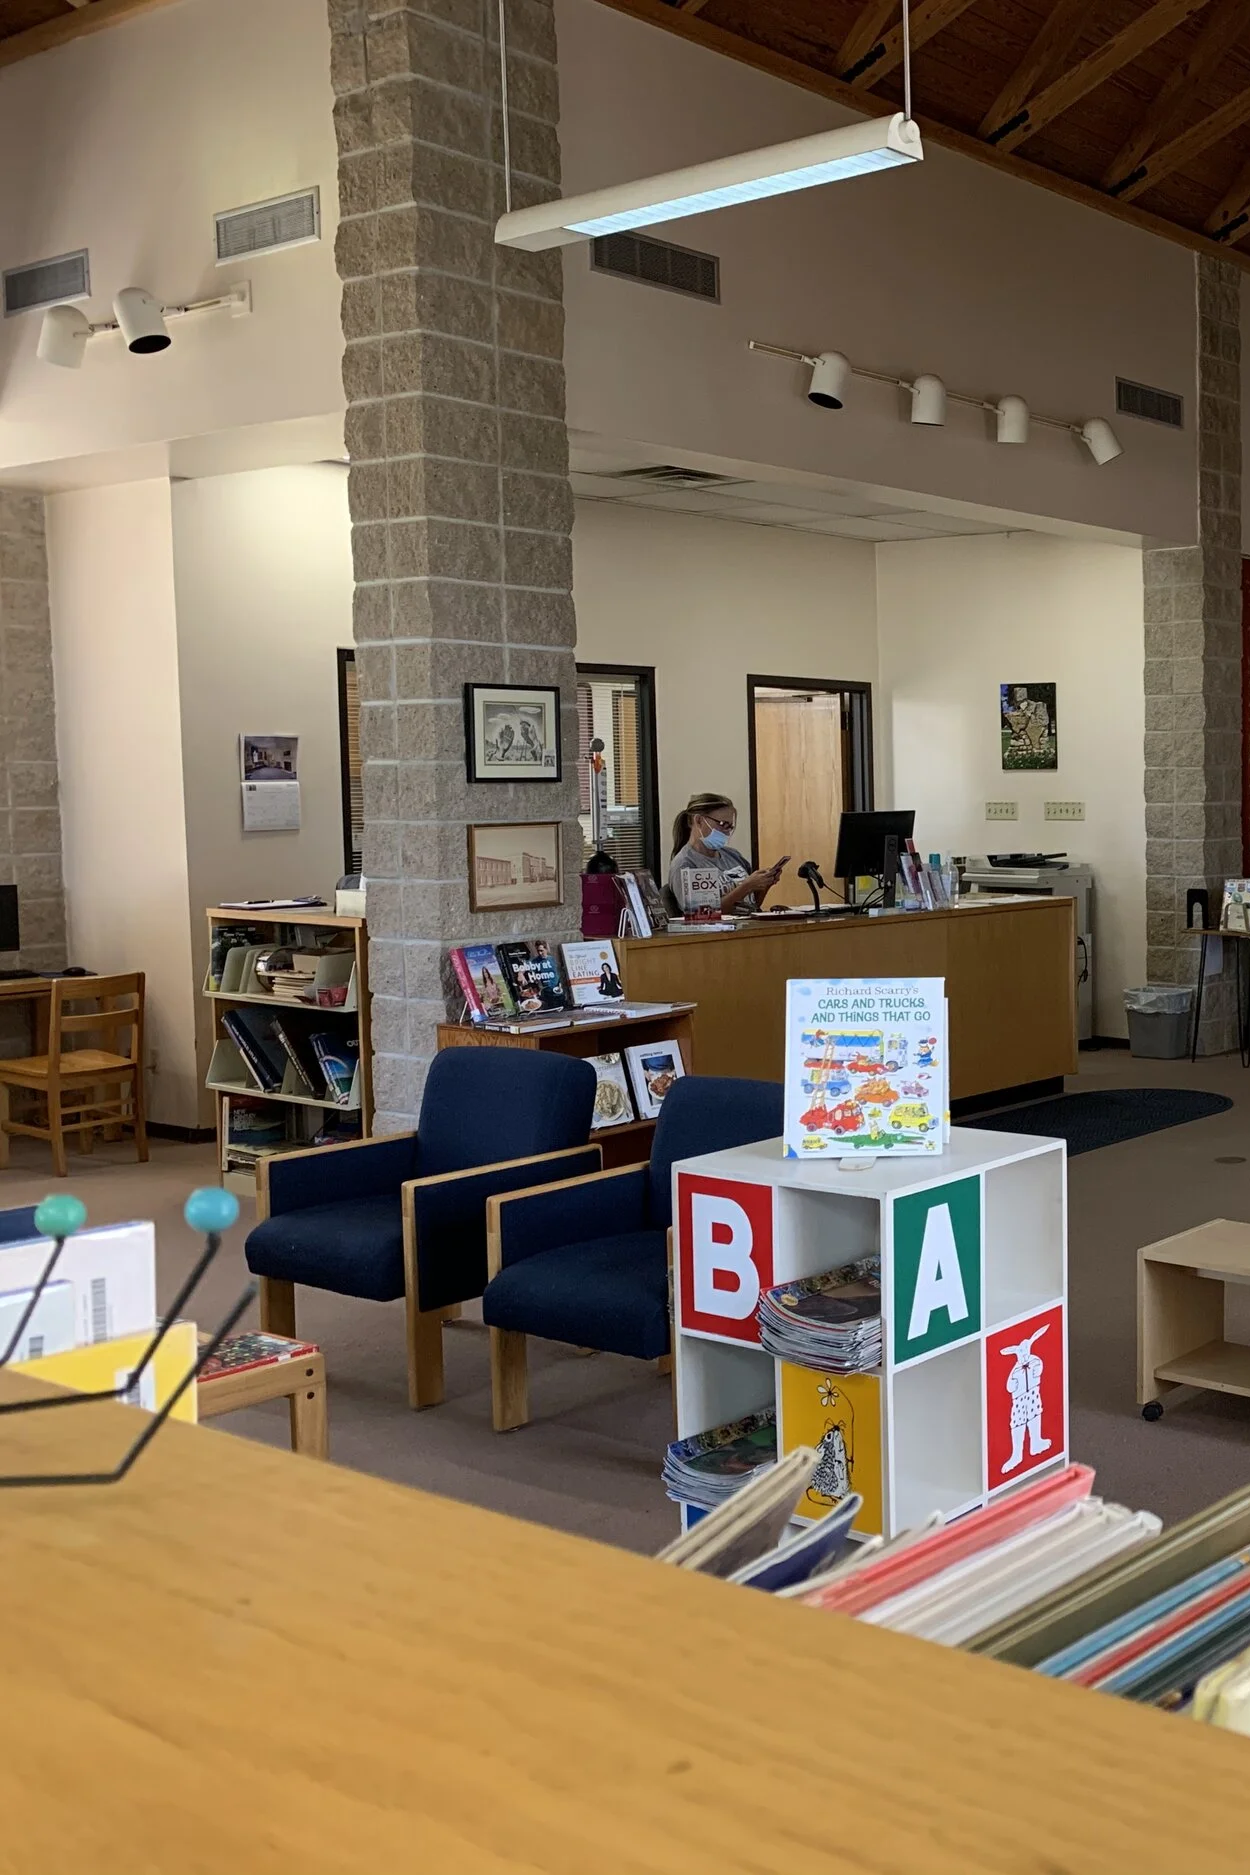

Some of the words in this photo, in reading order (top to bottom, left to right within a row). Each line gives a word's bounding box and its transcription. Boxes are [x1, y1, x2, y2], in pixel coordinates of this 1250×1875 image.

[695, 873, 703, 881] C.
[705, 872, 713, 880] J.
[692, 880, 717, 891] BOX
[512, 960, 541, 973] Bobby
[542, 959, 553, 969] at
[527, 971, 555, 984] Home
[572, 970, 600, 978] EATING
[826, 987, 872, 996] Richard
[874, 985, 919, 996] Scarry's
[818, 999, 848, 1010] CARS
[851, 998, 875, 1009] AND
[878, 998, 925, 1009] TRUCKS
[811, 1013, 835, 1024] AND
[882, 1011, 911, 1022] THAT
[913, 1011, 931, 1022] GO
[691, 1192, 760, 1320] B
[907, 1202, 969, 1341] A
